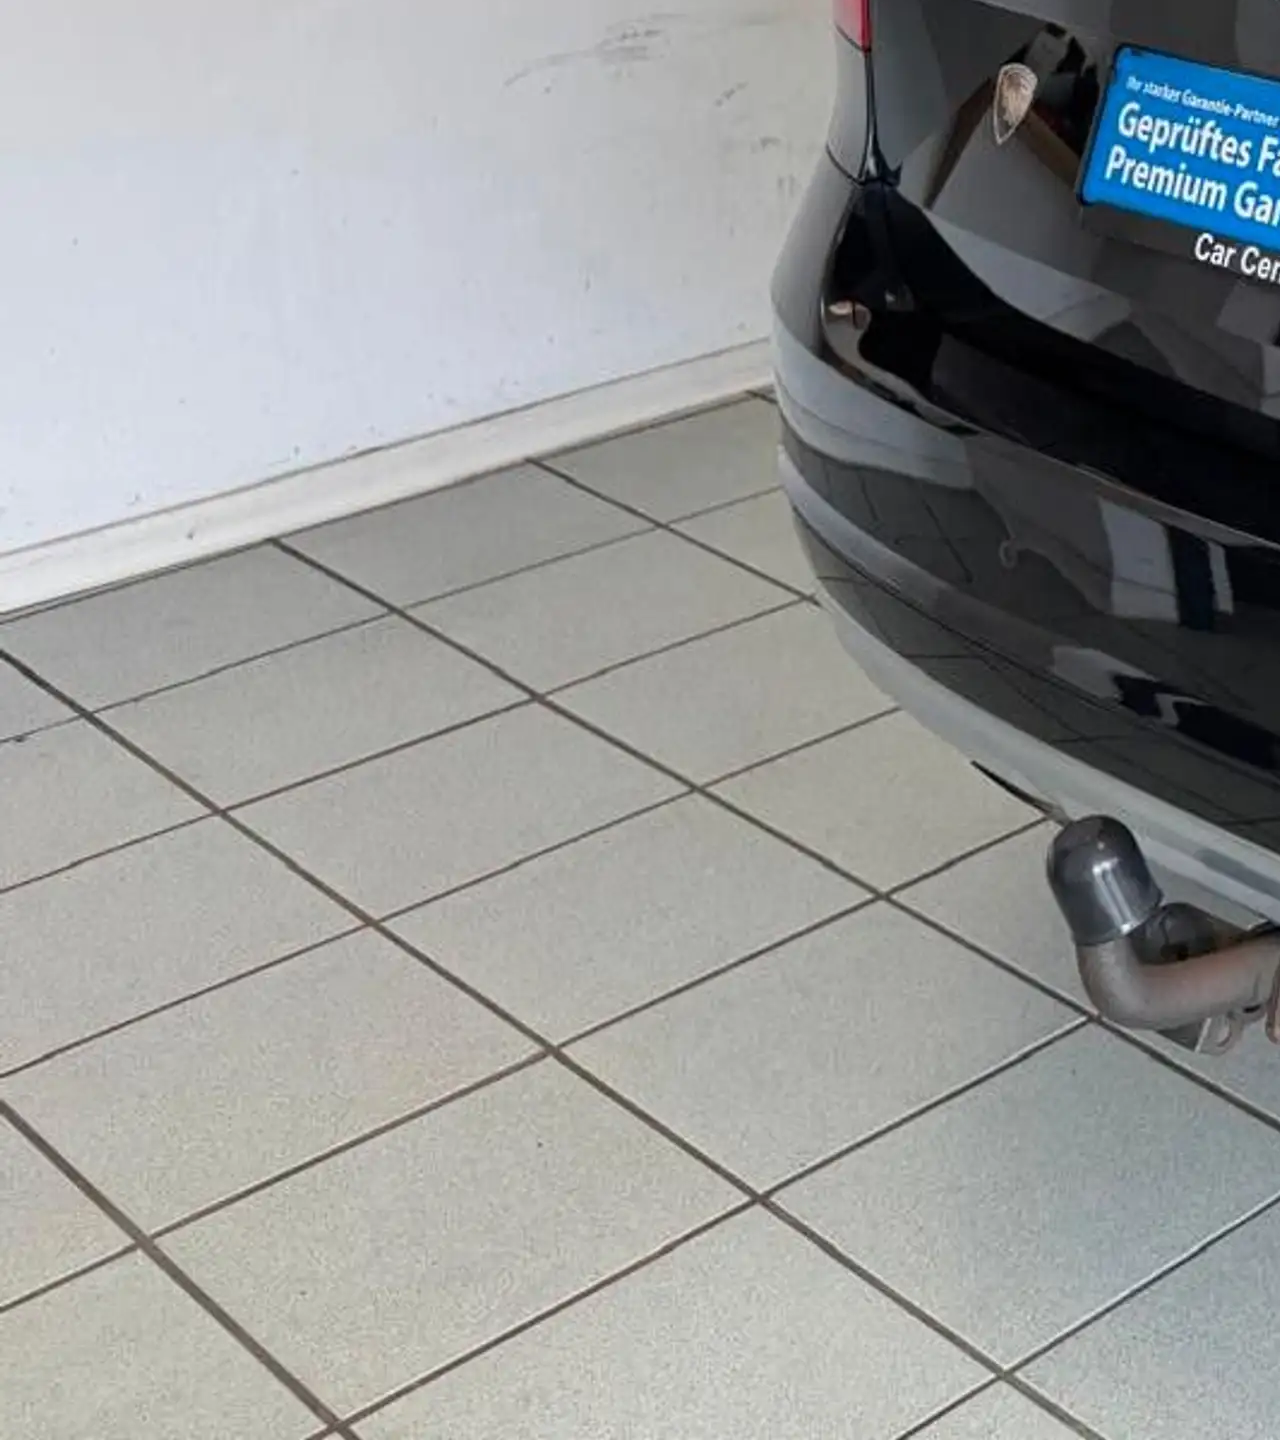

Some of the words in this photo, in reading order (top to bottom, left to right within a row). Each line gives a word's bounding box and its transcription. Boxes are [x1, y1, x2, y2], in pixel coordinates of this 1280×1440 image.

[1117, 101, 1253, 169] Geprüftes
[1104, 143, 1230, 212] Premium
[1194, 232, 1238, 269] Car
